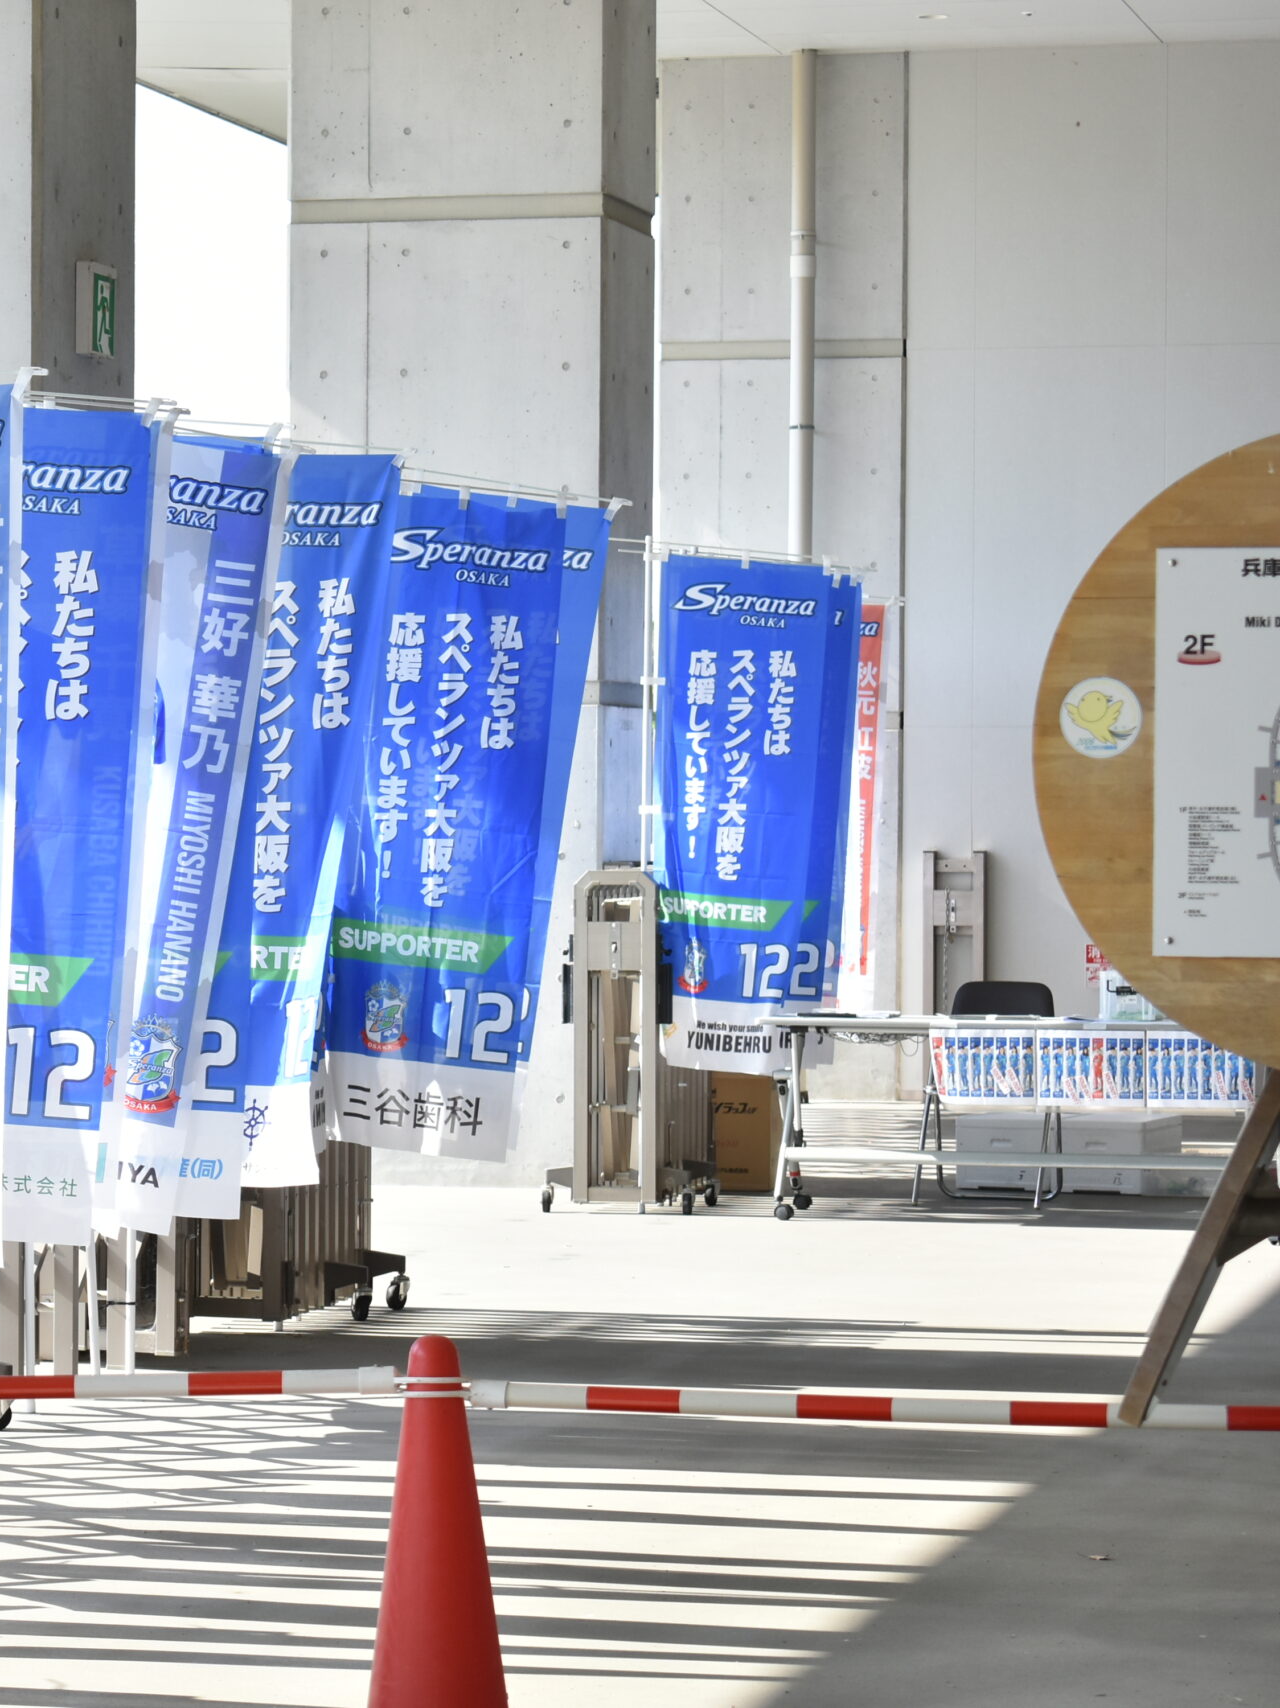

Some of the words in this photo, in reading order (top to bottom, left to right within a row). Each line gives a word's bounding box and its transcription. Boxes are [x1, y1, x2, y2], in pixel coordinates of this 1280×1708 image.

[22, 494, 82, 515] SAKA
[167, 506, 218, 531] SAKA
[285, 502, 382, 527] ranza
[391, 527, 551, 571] Speranza
[455, 569, 511, 588] OSAKA
[200, 560, 256, 658] 三好
[673, 582, 817, 616] Speranza
[45, 549, 99, 720] 私たちは
[739, 615, 786, 628] OSAKA
[1244, 616, 1271, 628] Miki
[312, 577, 356, 730] 私たちは
[1183, 634, 1216, 655] 2F
[480, 615, 524, 750] 私たちは
[763, 650, 798, 756] 私たちは
[182, 673, 240, 775] 華乃
[173, 790, 215, 895] MIYOSHI
[663, 895, 768, 924] SUPPORTER
[155, 899, 199, 1003] HANANO
[339, 926, 480, 963] SUPPORTER
[444, 988, 516, 1064] 12
[687, 1031, 773, 1054] YUNIBEHRU
[707, 1022, 727, 1031] wish
[8, 1026, 97, 1121] 12
[343, 1083, 483, 1136] 三谷歯科
